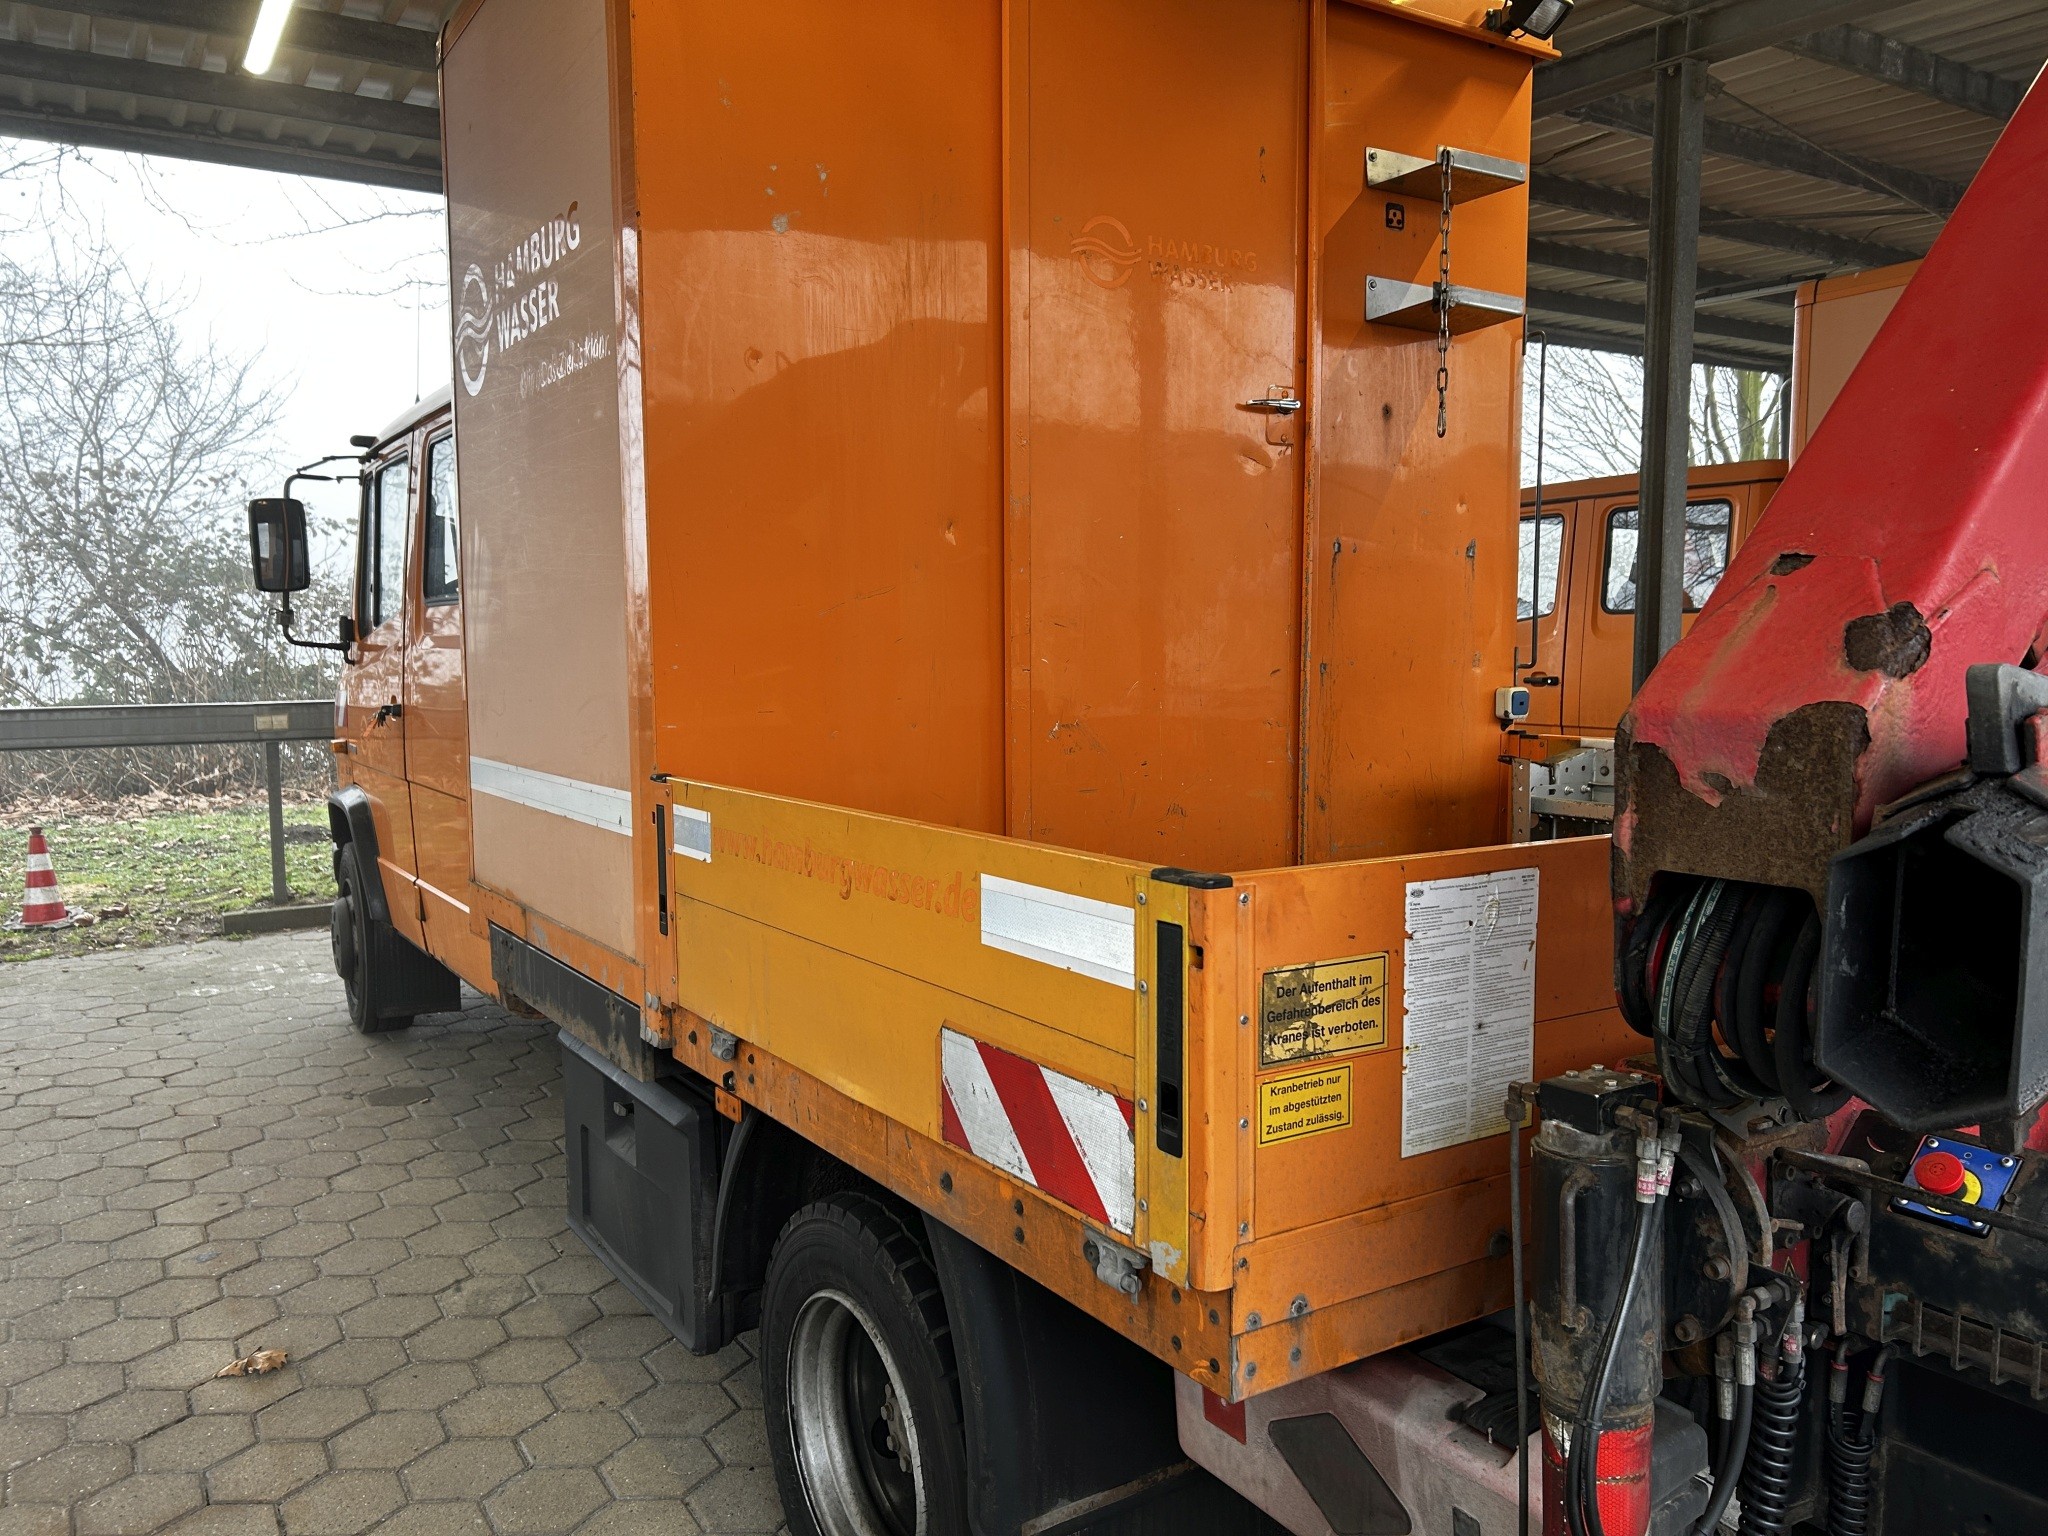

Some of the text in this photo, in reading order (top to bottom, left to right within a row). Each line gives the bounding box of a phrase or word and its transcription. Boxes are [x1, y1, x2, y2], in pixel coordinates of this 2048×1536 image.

[494, 201, 580, 303] HAMBURG
[1148, 235, 1257, 272] HAMBURG
[1149, 261, 1233, 293] WASSER
[496, 280, 560, 352] WASSER
[713, 826, 978, 922] www.hamburgwasser.de
[1277, 974, 1372, 999] Der Aufenthalt im
[1267, 995, 1381, 1023] Gefahrenbereich des
[1269, 1019, 1379, 1046] Kranes ist verboten.
[1270, 1075, 1341, 1096] Kranbetrieb nur
[1269, 1092, 1342, 1115] im abgestützten
[1266, 1110, 1345, 1135] Zustand zulässig.
